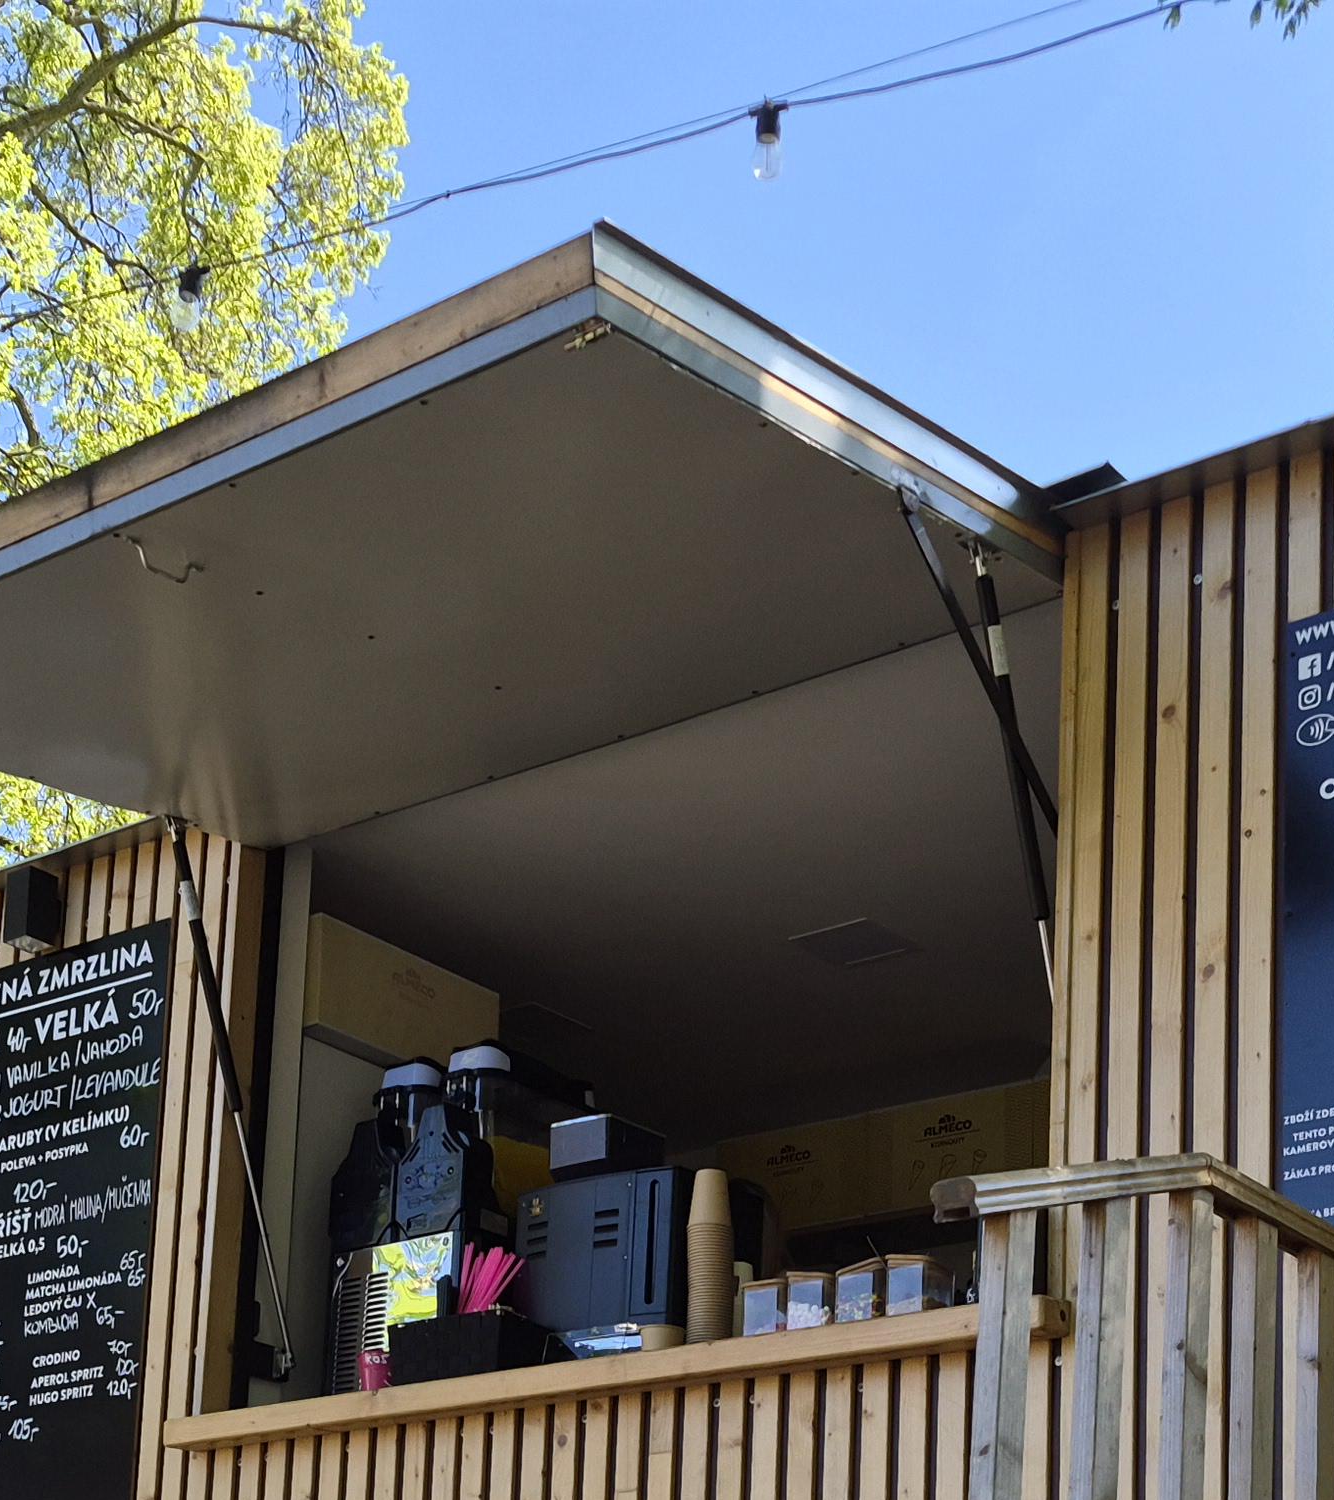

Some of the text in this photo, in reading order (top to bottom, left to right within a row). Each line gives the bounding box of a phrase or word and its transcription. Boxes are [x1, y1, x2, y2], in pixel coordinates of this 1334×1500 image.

[37, 940, 153, 995] ZMRZLINA
[35, 988, 119, 1044] VELKÁ
[7, 1051, 71, 1088] VANILKA
[4, 1084, 67, 1119] JOGURT
[45, 1122, 59, 1142] (V
[62, 1105, 130, 1137] KELÍMKU)
[1283, 1109, 1315, 1125] ZBOŽÍ
[1316, 1107, 1334, 1119] ZDE
[924, 1119, 972, 1137] ALMECO
[1293, 1129, 1326, 1142] TENTO
[0, 1155, 36, 1174] POLEVA
[45, 1142, 89, 1163] POSYPKA
[767, 1150, 811, 1166] ALMECO
[1283, 1166, 1317, 1181] ZÁKAZ
[28, 1237, 45, 1254] 0,5
[25, 1283, 66, 1300] MATCHA
[68, 1270, 122, 1293] LIMONÁDA
[27, 1264, 80, 1284] LIMONÁDA
[24, 1296, 63, 1317] LEDOVÝ
[64, 1294, 82, 1309] ČAJ
[32, 1349, 80, 1368] CRODINO
[30, 1372, 69, 1389] APEROL
[71, 1366, 104, 1382] SPRITZ
[29, 1390, 59, 1406] HUGO
[60, 1384, 94, 1401] SPRITZ
